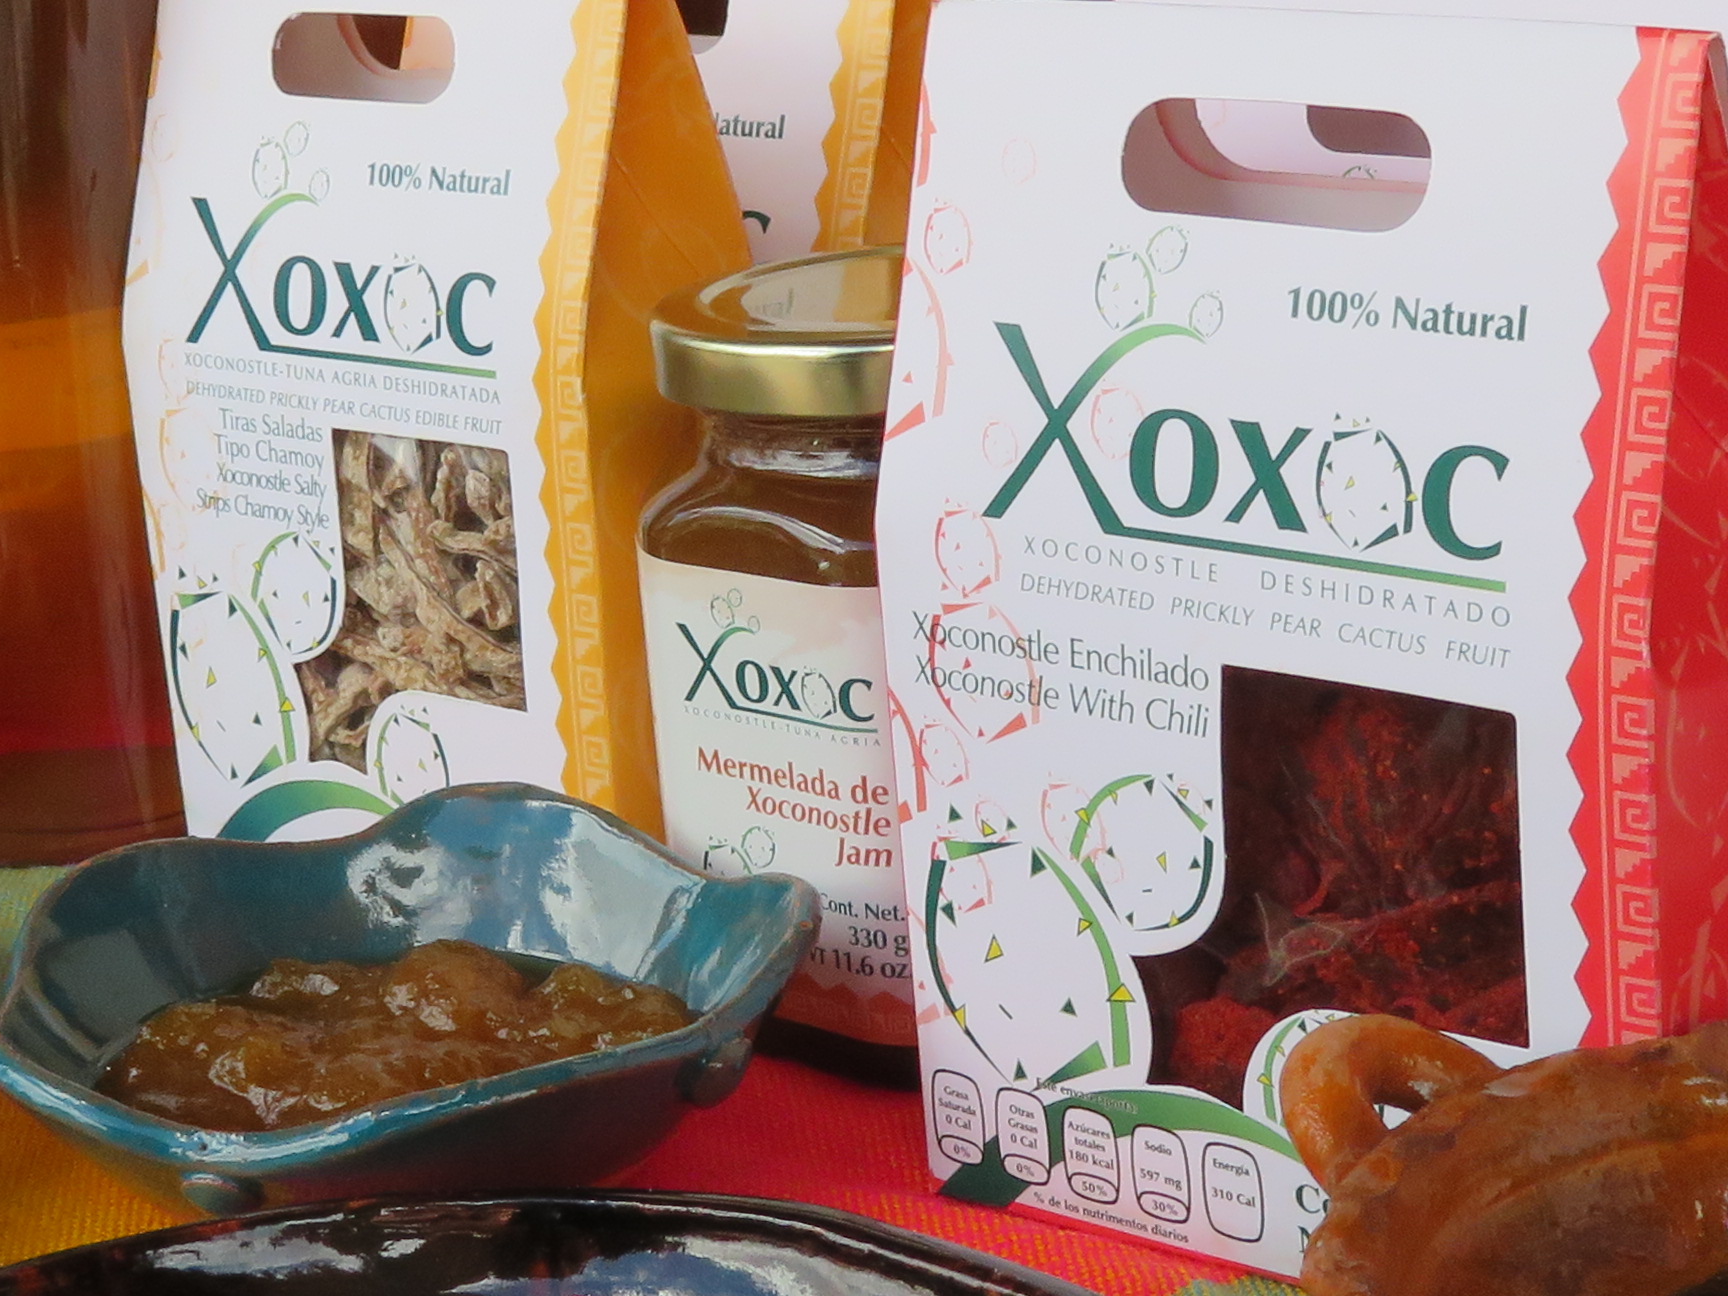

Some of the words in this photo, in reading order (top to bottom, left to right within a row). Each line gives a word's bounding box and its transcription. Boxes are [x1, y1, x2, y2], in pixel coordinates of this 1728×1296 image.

[366, 161, 423, 192] 100%
[428, 166, 512, 197] Natural
[185, 191, 497, 380] Xoxoc
[1286, 285, 1381, 330] 100%
[1391, 294, 1530, 343] Natural
[184, 352, 326, 384] XOCONOSTLE-TUNA
[331, 370, 379, 390] AGRIA
[383, 376, 502, 406] DESHIDRATADA
[186, 380, 266, 405] DEHYDRATED
[270, 390, 320, 412] PRICKLY
[323, 397, 356, 416] PEAR
[360, 402, 411, 424] CACTUS
[415, 409, 461, 431] EDIBLE
[464, 416, 503, 435] FRUIT
[218, 407, 258, 434] Tiras
[262, 413, 324, 443] Saladas
[213, 433, 250, 464] Tipo
[255, 440, 325, 477] Chamoy
[981, 320, 1511, 594] Xoxoc
[216, 461, 292, 494] Xoconostle
[294, 472, 328, 501] Salty
[195, 487, 231, 519] Strips
[234, 496, 294, 530] Chamoy
[296, 505, 330, 535] Style
[1022, 534, 1220, 584] XOCONOSTLE
[1260, 569, 1512, 629] DESHIDRATADO
[1019, 572, 1156, 613] DEHYDRATED
[1169, 595, 1257, 628] PRICKLY
[1270, 611, 1323, 639] PEAR
[1337, 622, 1428, 657] CACTUS
[1444, 639, 1512, 670] FRUIT
[912, 610, 1061, 666] Xoconostle
[1069, 637, 1211, 693] Enchilado
[675, 621, 879, 733] Xoxoc
[914, 654, 1060, 710] Xoconostle
[1068, 683, 1136, 726] With
[1143, 695, 1211, 739] Chili
[683, 705, 822, 740] XOCONOSTLE-TUNA
[830, 734, 882, 747] AGRIA
[697, 746, 842, 801] Mermelada
[850, 775, 890, 805] de
[745, 785, 892, 837] Xoconostle
[834, 836, 894, 868] Jam
[820, 892, 859, 918] Cont.
[865, 902, 906, 922] Net.
[848, 925, 888, 950] 330
[893, 934, 909, 958] g
[833, 949, 875, 977] 11.6
[943, 1085, 970, 1102] Grasa
[1036, 1076, 1058, 1093] Este
[937, 1096, 978, 1117] Saturada
[1008, 1104, 1036, 1120] Otras
[945, 1114, 953, 1125] 0
[954, 1115, 972, 1132] Cal
[1007, 1117, 1039, 1135] Grasas
[1068, 1120, 1112, 1141] Azúcares
[952, 1143, 972, 1159] 0%
[1010, 1132, 1017, 1144] 0
[1020, 1135, 1038, 1151] Cal
[1074, 1136, 1106, 1153] totales
[1143, 1139, 1173, 1158] Sodio
[1015, 1162, 1036, 1178] 0%
[1069, 1149, 1090, 1165] 180
[1092, 1154, 1115, 1171] kcal
[1212, 1157, 1251, 1179] Energía
[1081, 1181, 1109, 1198] 50%
[1139, 1167, 1161, 1183] 597
[1163, 1175, 1183, 1193] mg
[1151, 1199, 1179, 1217] 30%
[1210, 1186, 1234, 1202] 310
[1236, 1192, 1257, 1209] Cal
[1033, 1191, 1045, 1205] %
[1048, 1195, 1062, 1209] de
[1064, 1198, 1080, 1215] los
[1082, 1207, 1149, 1233] nutrimentos
[1151, 1223, 1190, 1244] diarios
